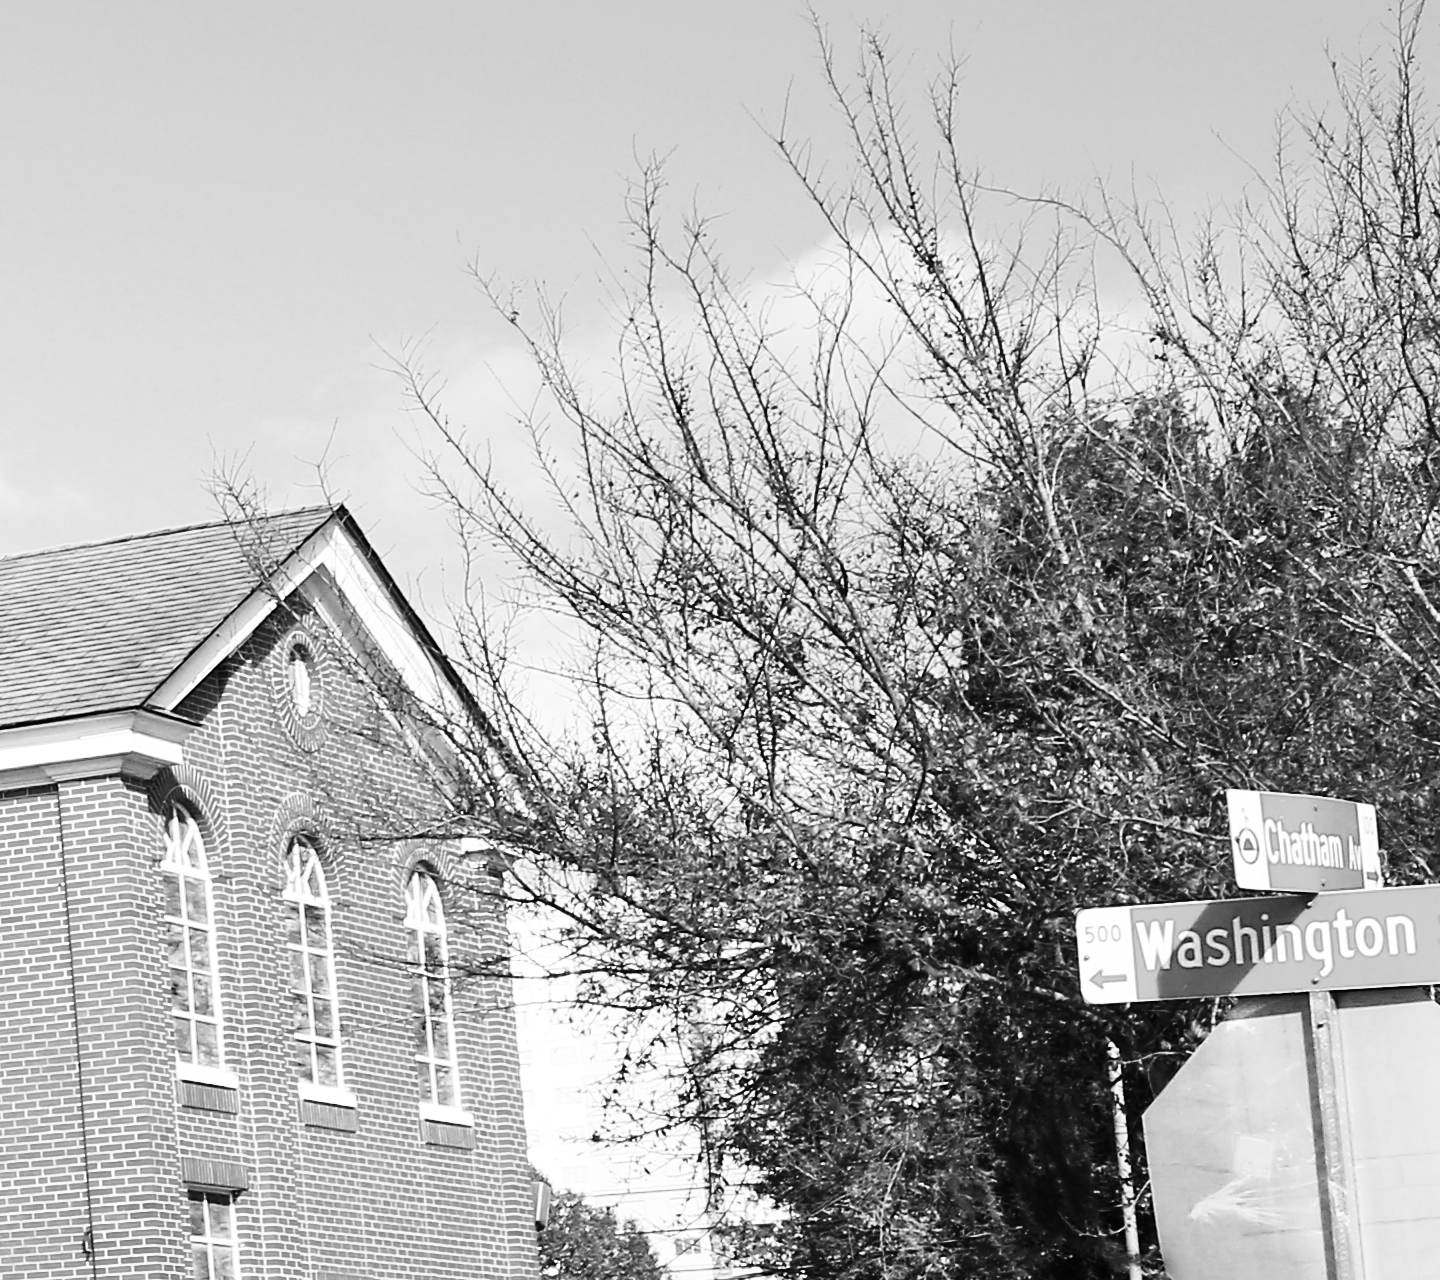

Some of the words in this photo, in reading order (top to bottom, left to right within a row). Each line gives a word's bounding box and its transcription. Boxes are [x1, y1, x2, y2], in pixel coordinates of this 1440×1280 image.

[1264, 818, 1345, 869] Chatham
[1084, 925, 1122, 943] 500
[1135, 908, 1417, 978] Washington
